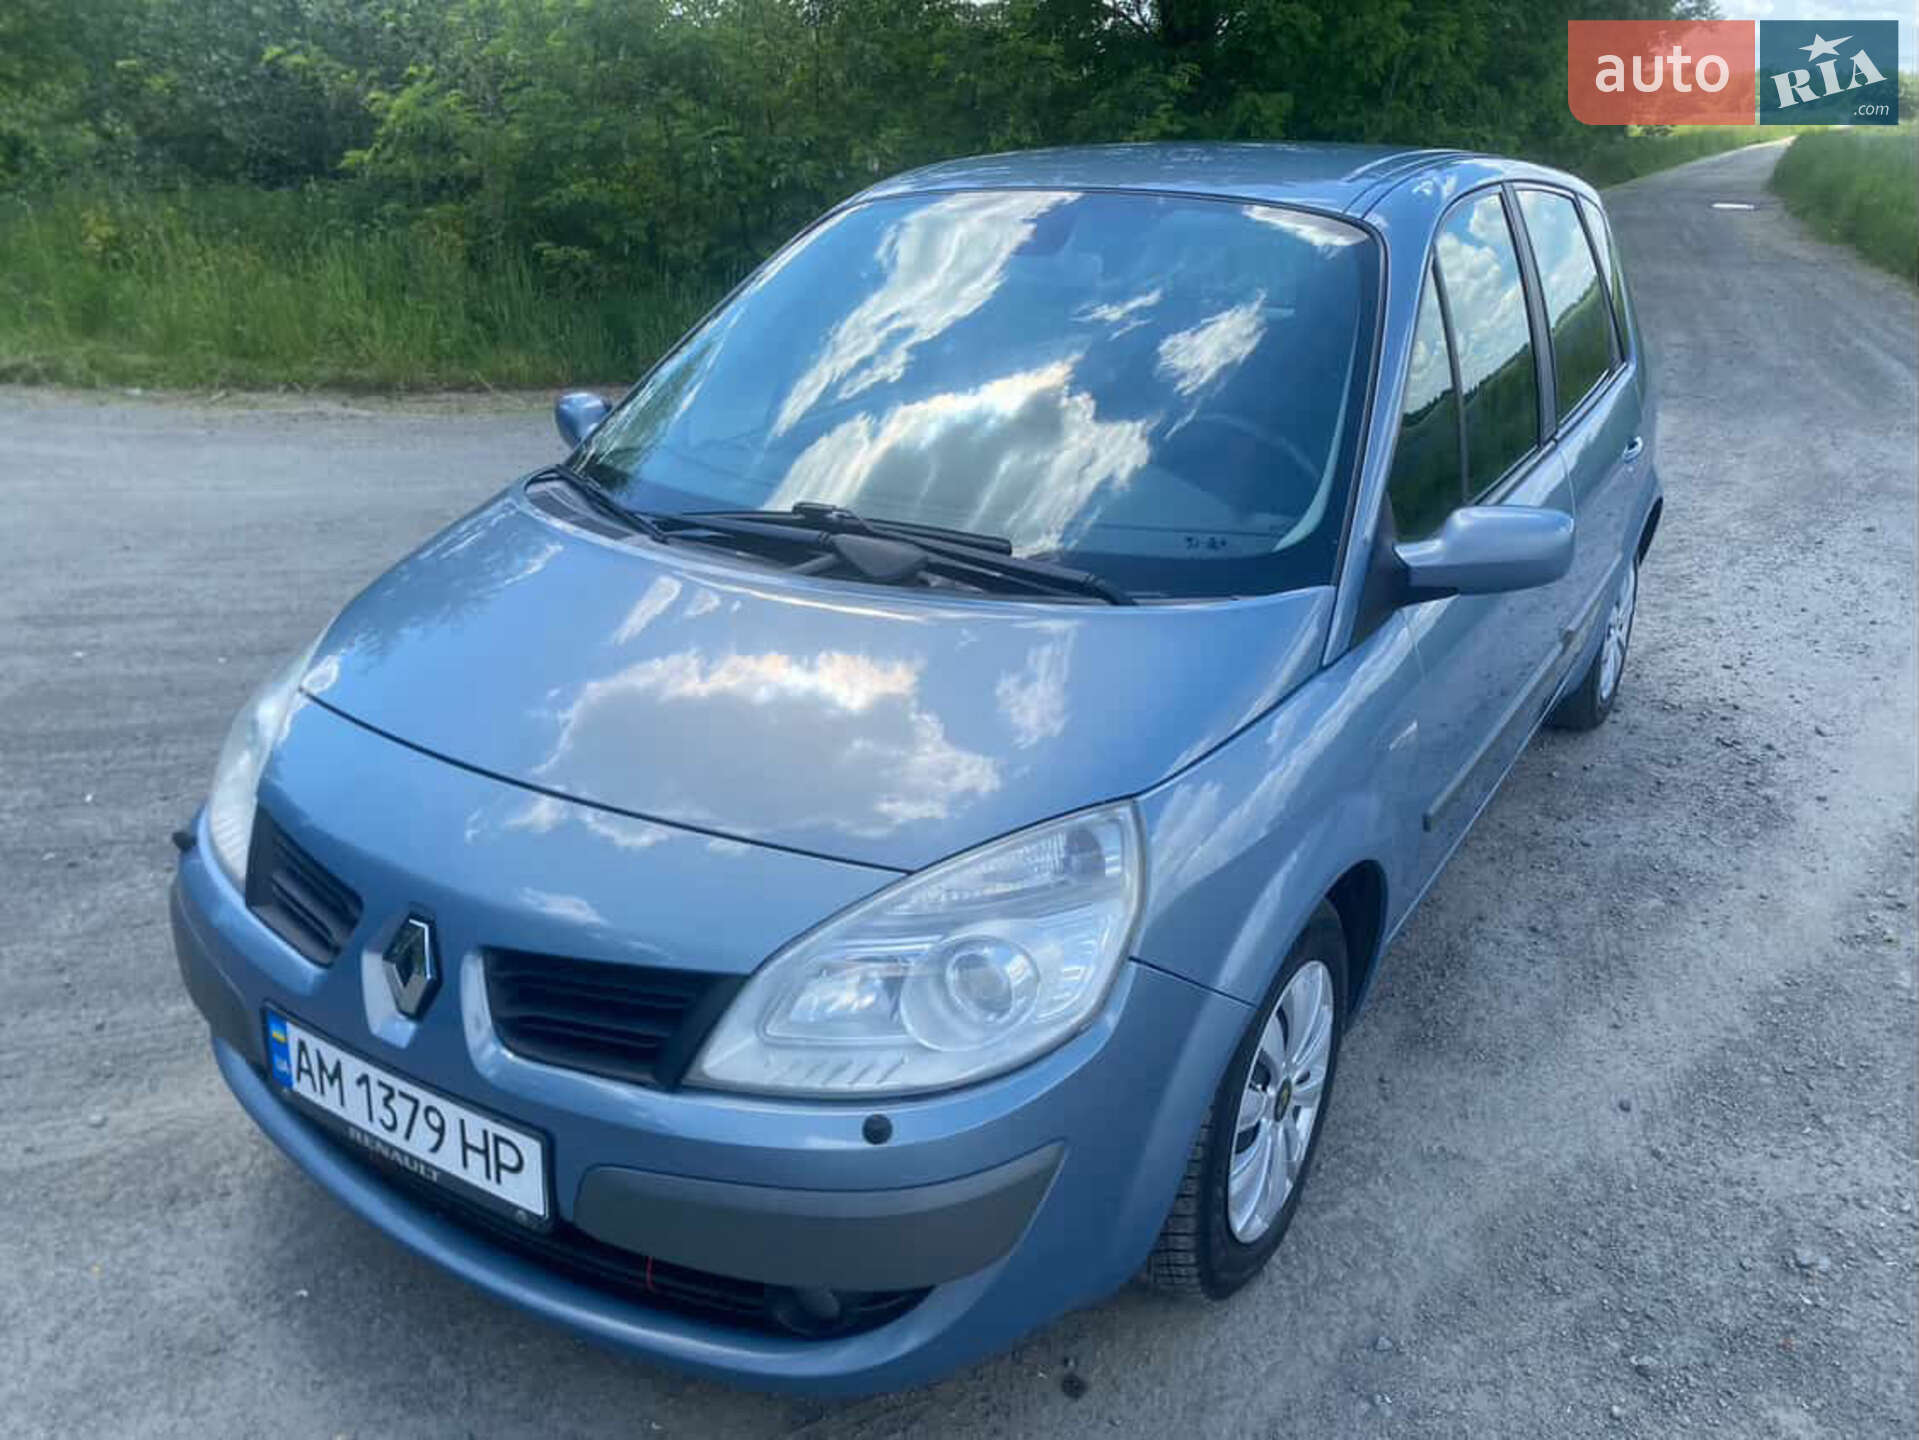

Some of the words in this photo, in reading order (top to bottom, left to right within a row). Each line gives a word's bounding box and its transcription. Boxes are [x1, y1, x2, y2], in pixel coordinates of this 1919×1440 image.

[296, 1038, 345, 1108] AM
[355, 1073, 447, 1153] 1379
[459, 1118, 525, 1185] HP
